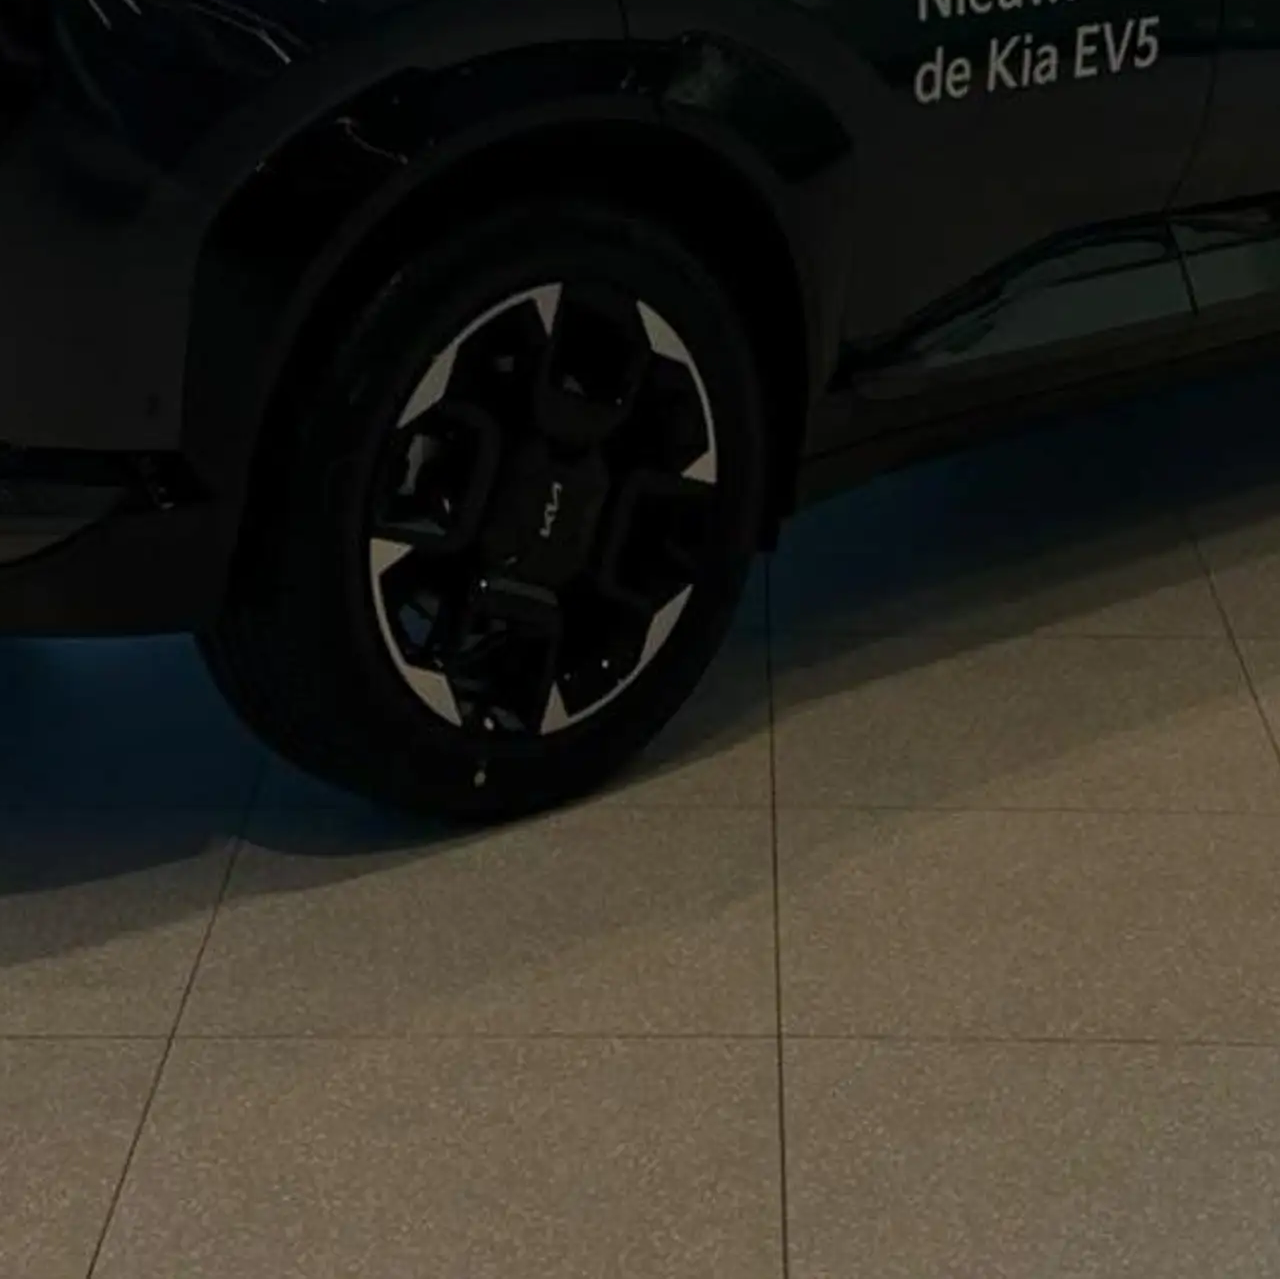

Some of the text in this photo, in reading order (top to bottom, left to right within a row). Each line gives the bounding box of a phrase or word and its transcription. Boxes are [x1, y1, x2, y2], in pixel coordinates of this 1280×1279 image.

[913, 15, 1160, 105] de Kia EV5
